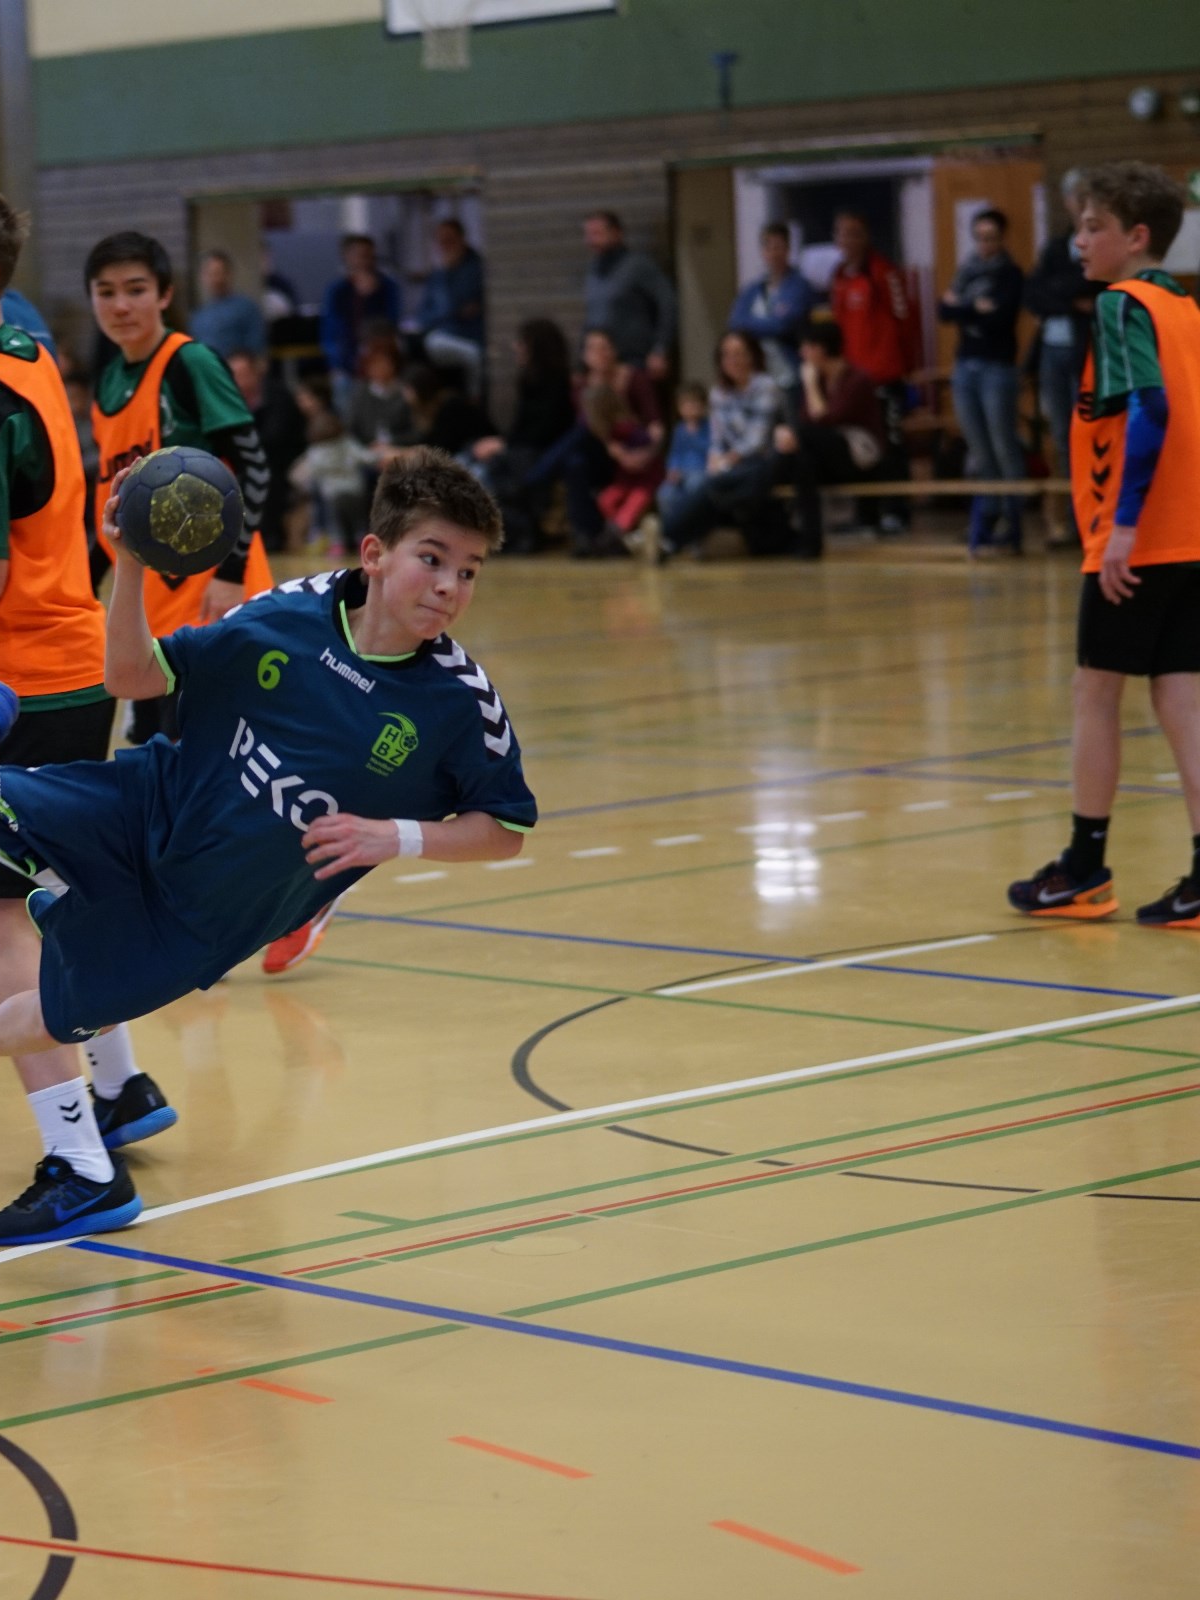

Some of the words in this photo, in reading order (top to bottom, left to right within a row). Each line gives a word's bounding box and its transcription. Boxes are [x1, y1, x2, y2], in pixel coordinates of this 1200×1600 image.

[257, 650, 289, 690] 6
[320, 647, 376, 694] hummel
[229, 717, 339, 832] PEKO
